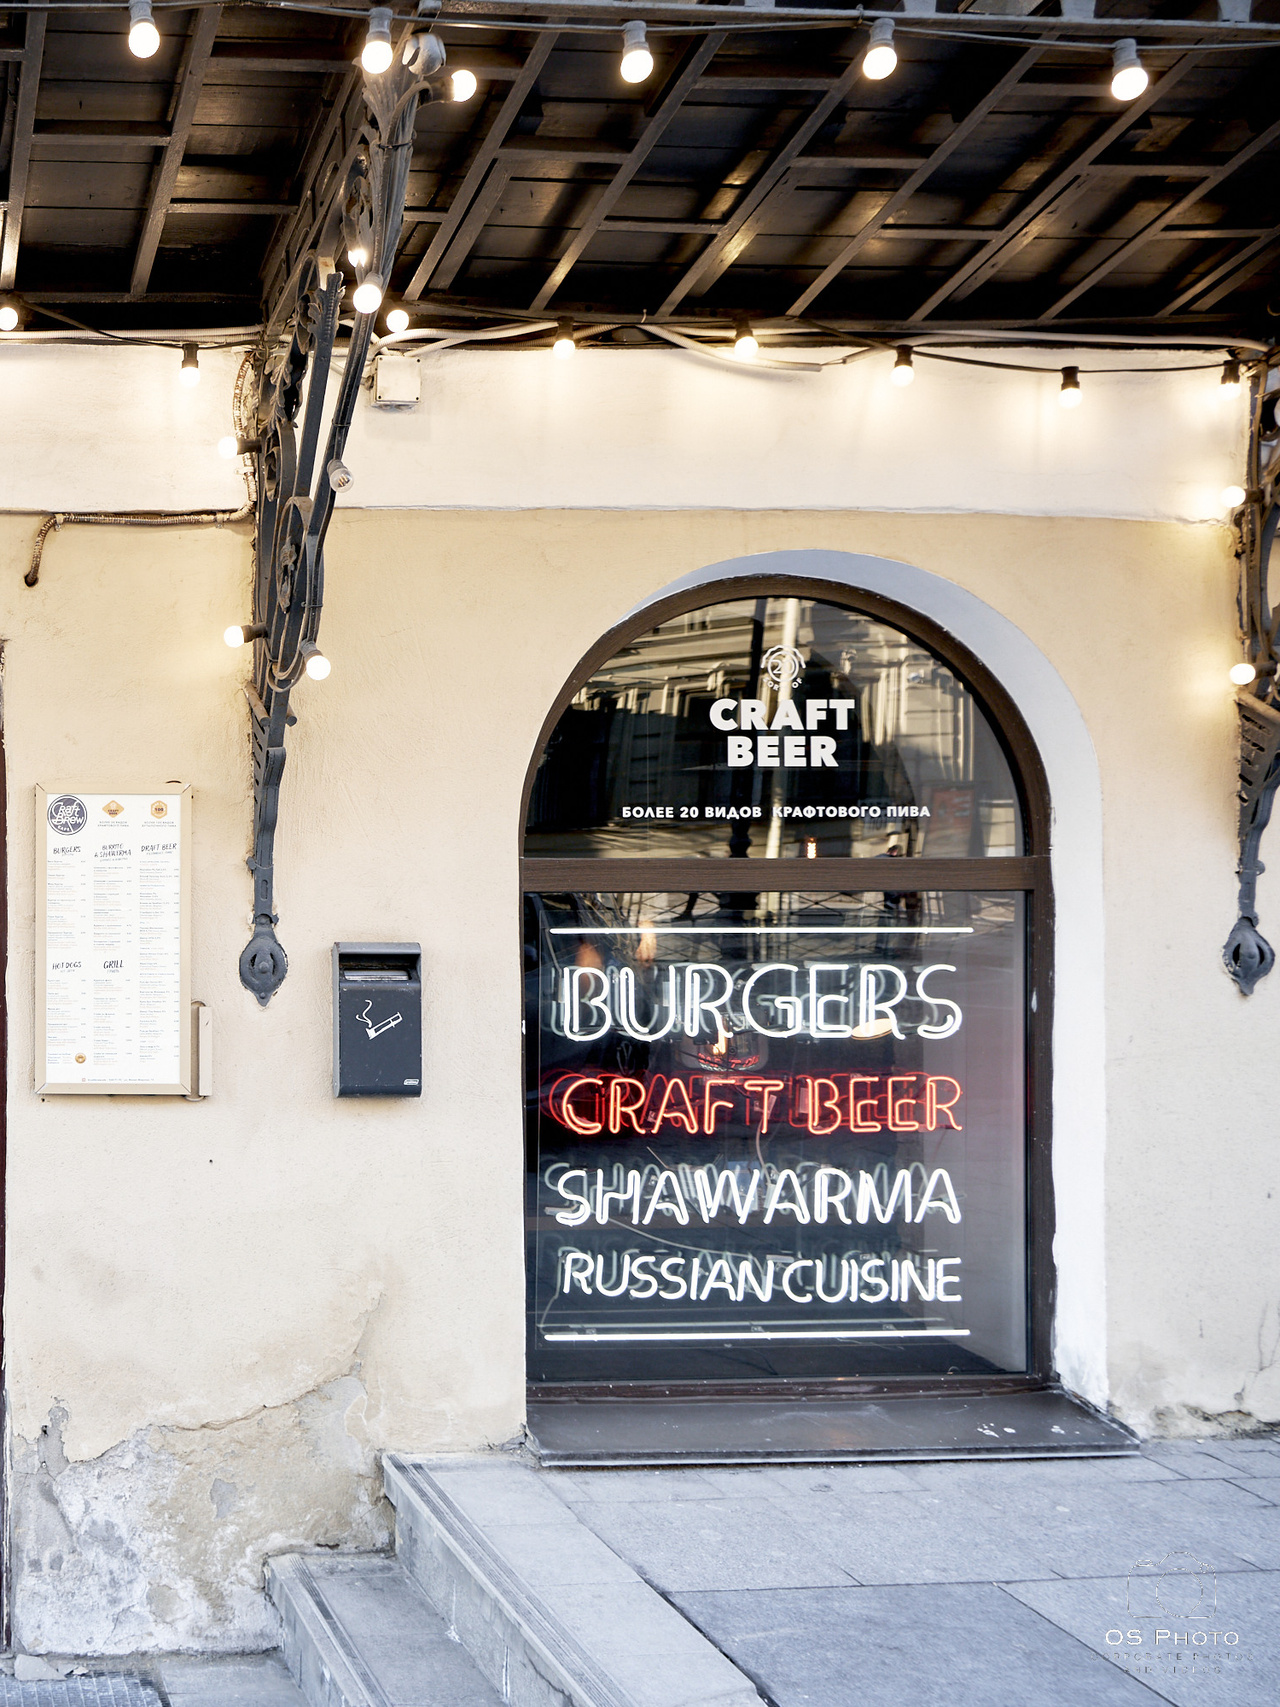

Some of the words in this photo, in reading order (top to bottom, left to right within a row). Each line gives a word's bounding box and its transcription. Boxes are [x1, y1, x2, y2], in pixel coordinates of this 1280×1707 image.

[791, 677, 803, 689] OF
[709, 698, 856, 732] CRAFT
[727, 735, 839, 768] BEER
[622, 806, 674, 818] БОЛЕЕ
[680, 806, 699, 818] 20
[705, 806, 762, 820] ВИДОВ
[772, 805, 882, 818] КРАФТОВОГО
[886, 805, 931, 818] ПИВА
[53, 845, 81, 855] BURGERS
[103, 959, 124, 970] GRILL
[563, 963, 963, 1042] BURGERS
[561, 1077, 784, 1135] CRAFT
[806, 1076, 963, 1135] BEER
[555, 1167, 962, 1226] SHAWARMA
[562, 1252, 773, 1302] RUSSIAN
[782, 1257, 962, 1303] CUISINE
